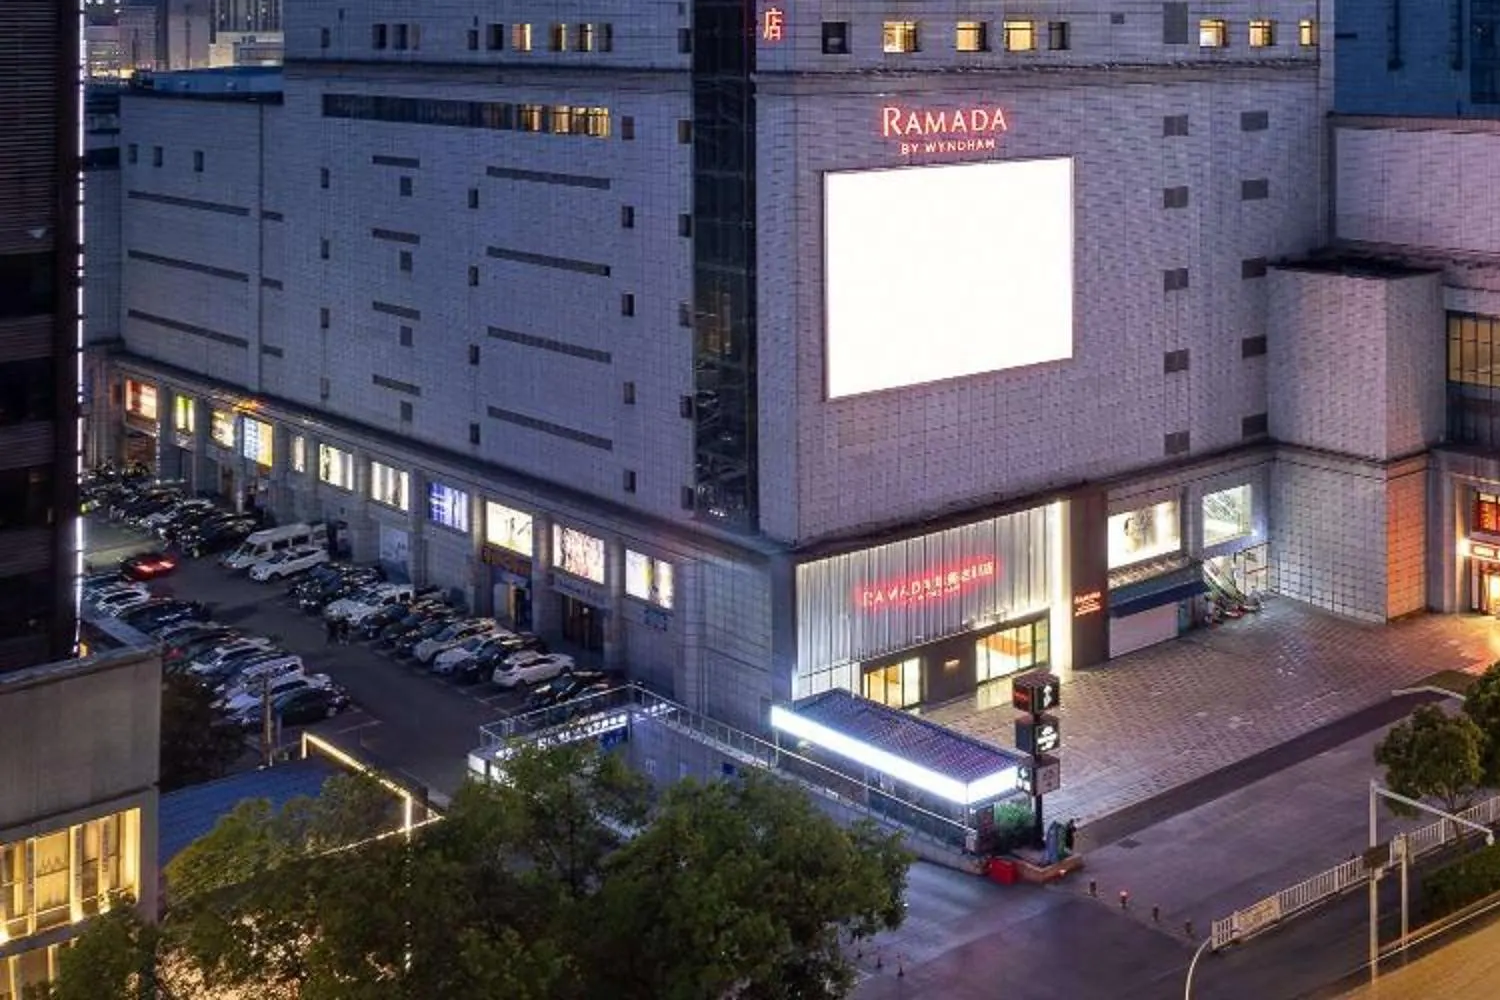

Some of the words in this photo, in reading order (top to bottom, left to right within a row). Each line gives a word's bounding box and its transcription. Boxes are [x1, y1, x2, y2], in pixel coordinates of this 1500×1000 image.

[882, 106, 1008, 138] RAMADA
[901, 142, 919, 155] BY
[925, 138, 995, 153] WYNDHAM
